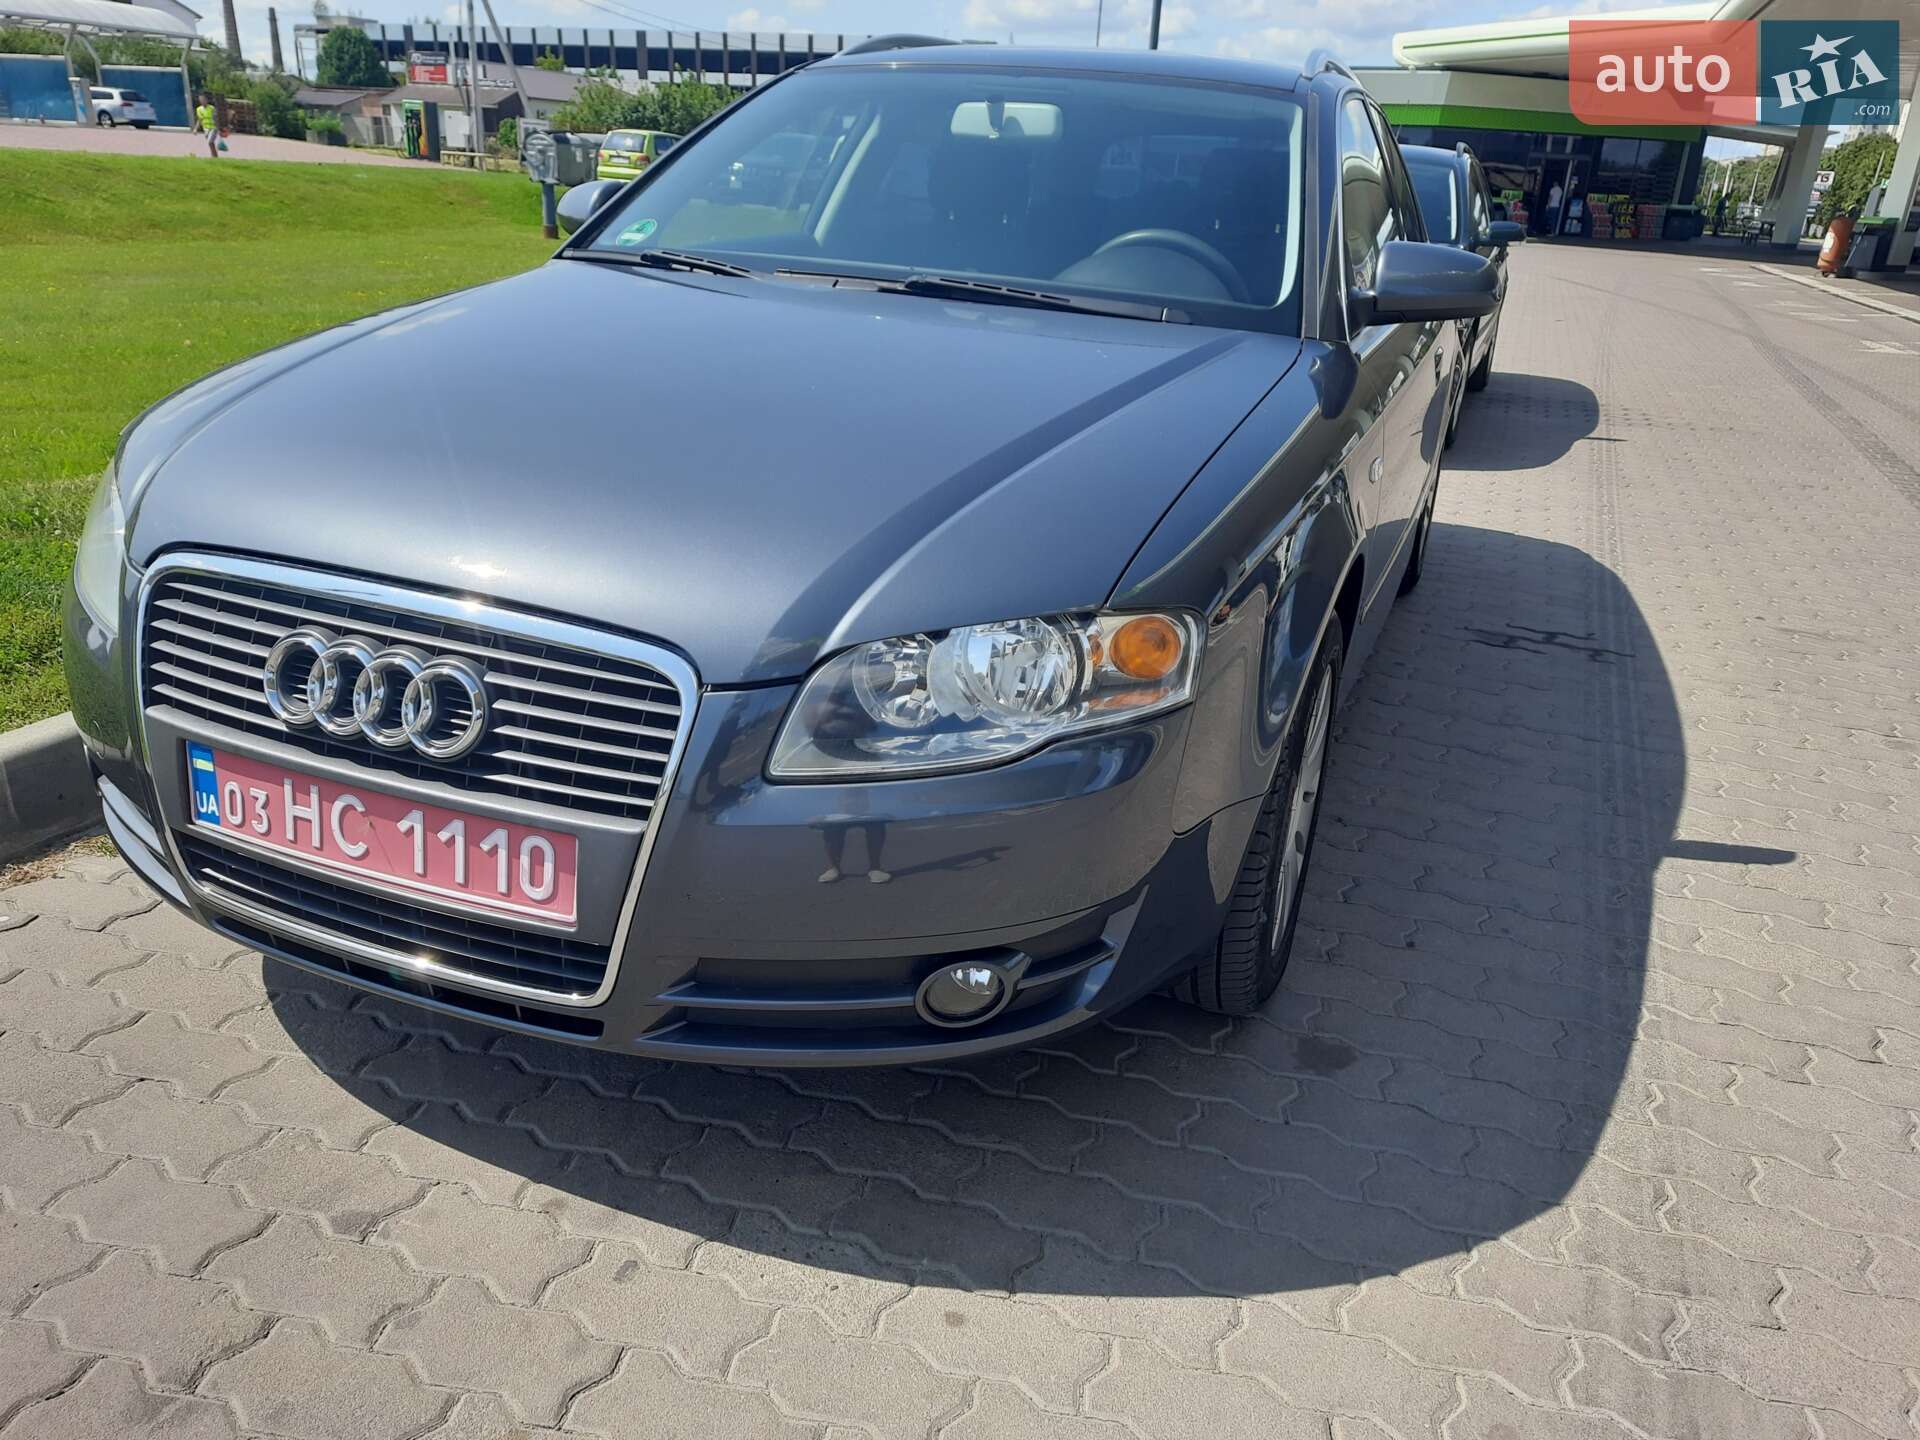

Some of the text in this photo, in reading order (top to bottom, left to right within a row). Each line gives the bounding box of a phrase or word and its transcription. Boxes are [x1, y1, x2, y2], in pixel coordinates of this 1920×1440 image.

[195, 789, 220, 817] UA
[224, 777, 555, 901] 03 HC 1110
